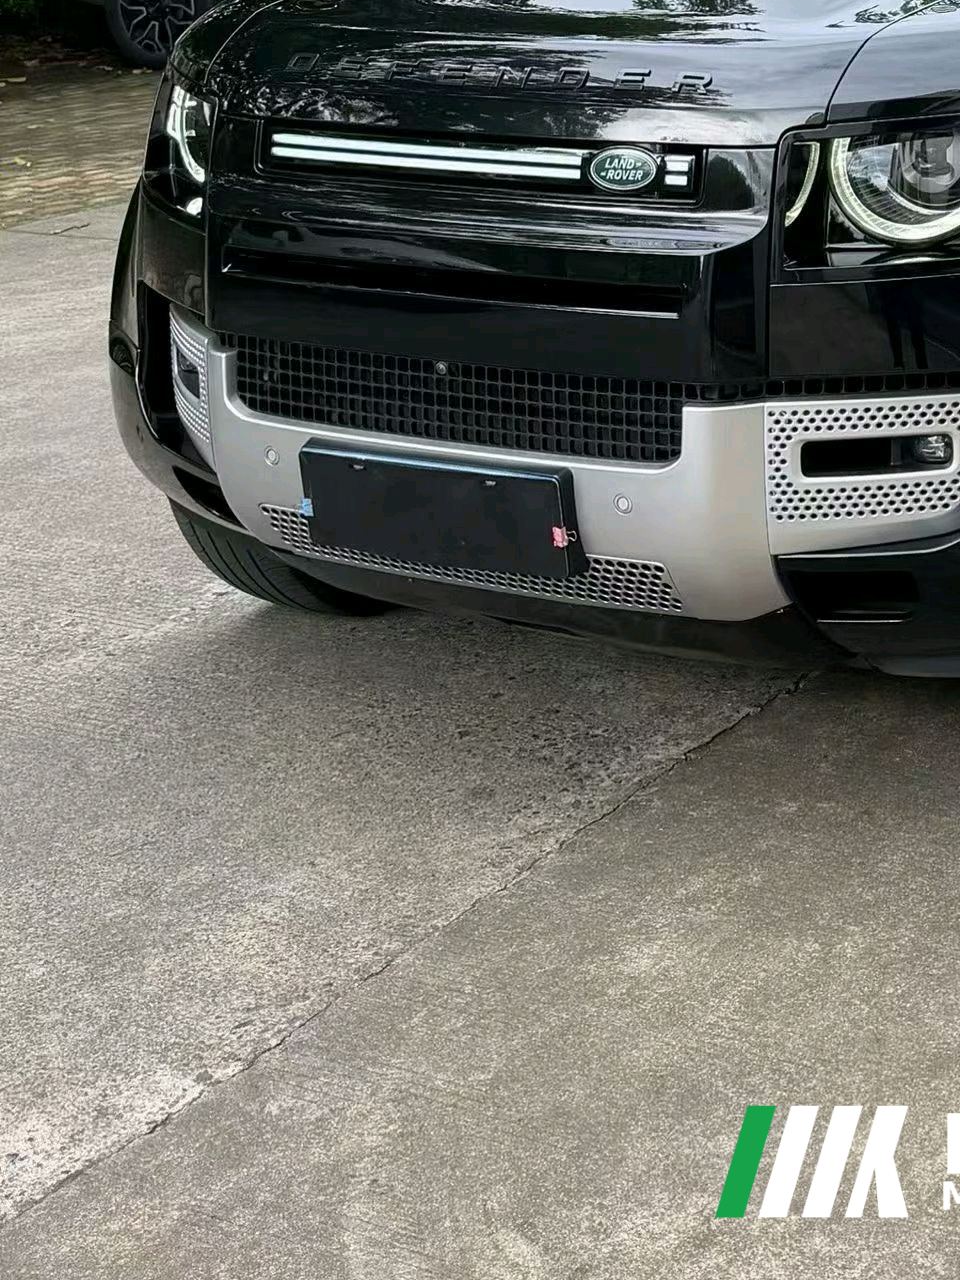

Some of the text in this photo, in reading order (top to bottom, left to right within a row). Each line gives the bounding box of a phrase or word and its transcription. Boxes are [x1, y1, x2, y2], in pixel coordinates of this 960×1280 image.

[285, 52, 714, 95] DEFENDER
[605, 156, 635, 170] LAND
[606, 169, 643, 181] ROVER
